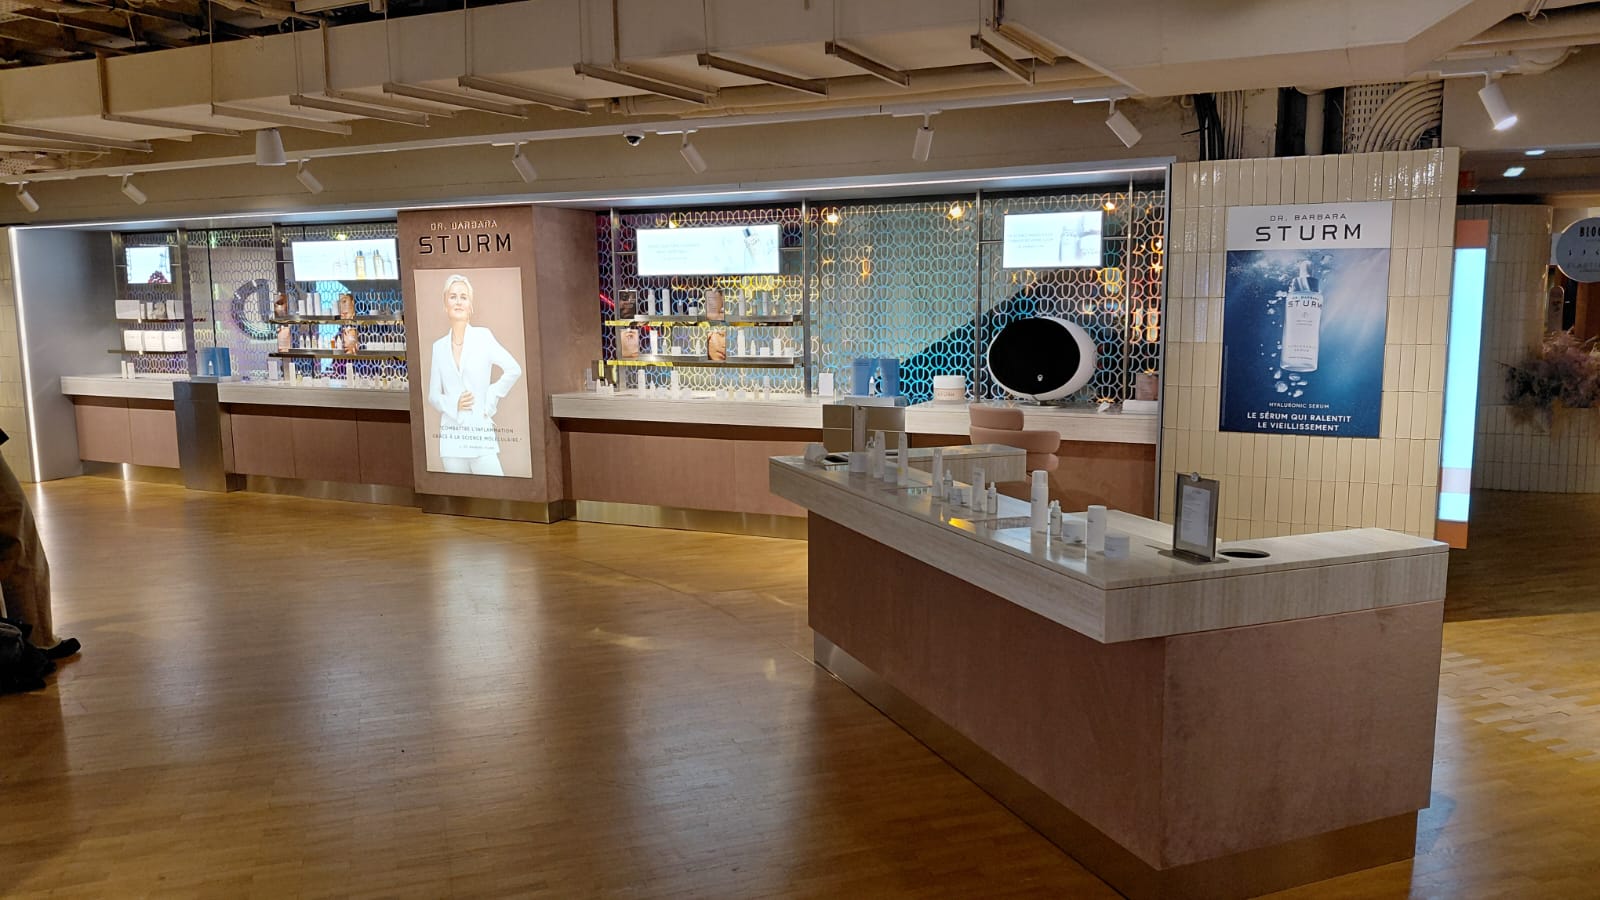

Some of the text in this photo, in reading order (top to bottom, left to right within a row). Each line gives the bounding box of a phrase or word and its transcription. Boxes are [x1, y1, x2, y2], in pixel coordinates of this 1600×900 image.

[1295, 213, 1347, 221] BARBARA
[430, 220, 498, 231] DR. BARBARA
[1255, 224, 1361, 242] STURM
[419, 233, 512, 255] STURM
[1288, 300, 1323, 309] STURM
[1259, 411, 1288, 420] SÉRUM
[1291, 413, 1307, 421] QUI
[1310, 415, 1352, 423] RALENTIT
[1270, 422, 1340, 431] VIEILLISSEMENT
